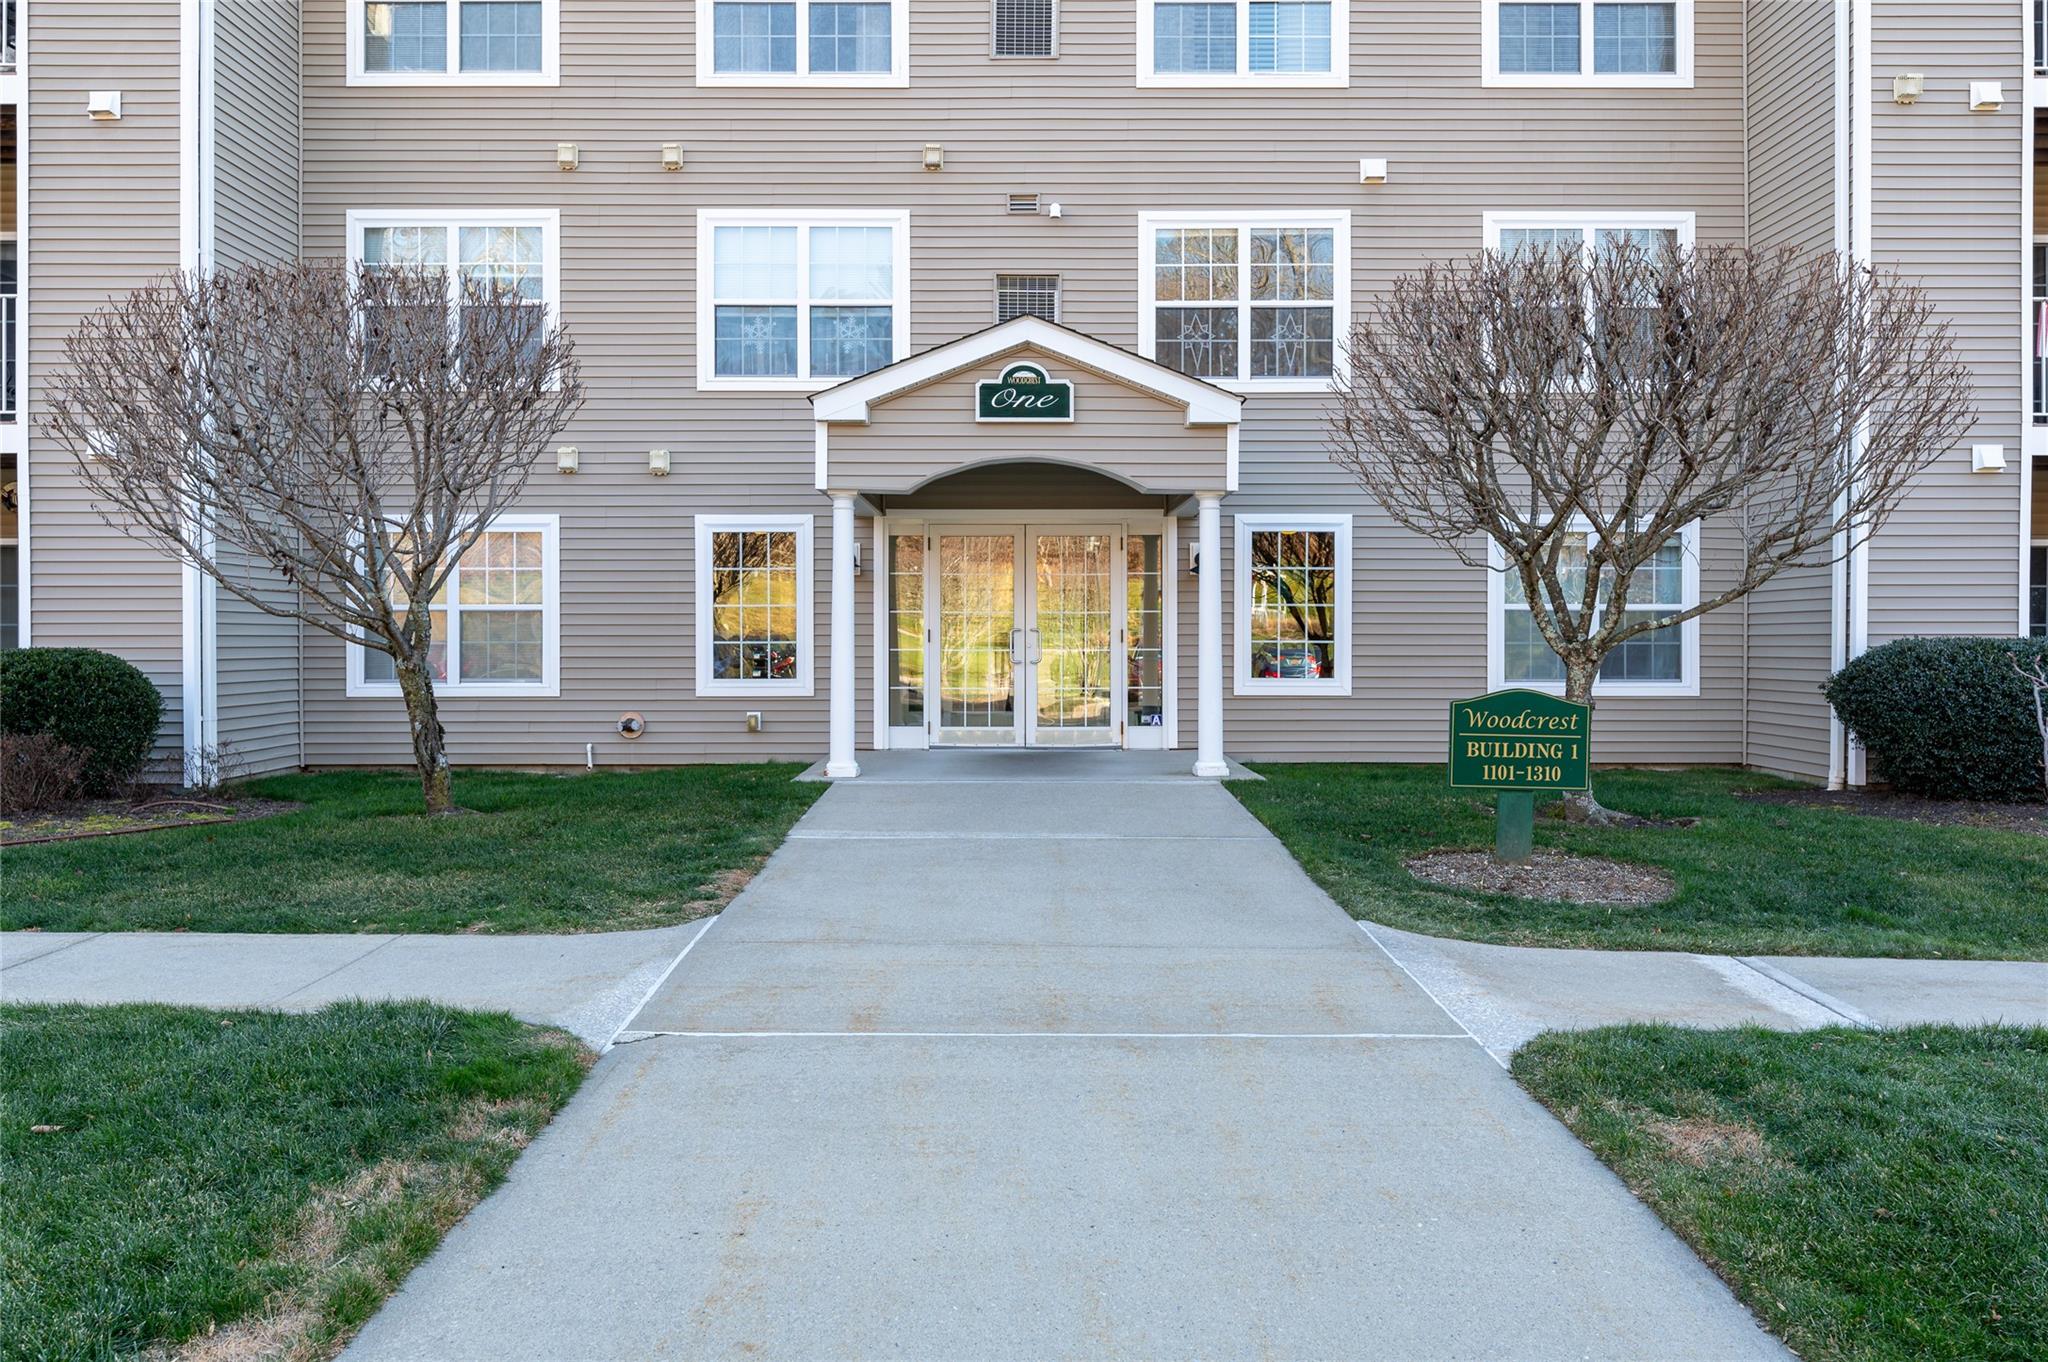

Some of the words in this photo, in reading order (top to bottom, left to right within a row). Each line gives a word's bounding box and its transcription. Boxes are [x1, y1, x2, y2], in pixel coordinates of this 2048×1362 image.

[991, 388, 1060, 408] One
[1463, 708, 1579, 730] Woodcrest
[1466, 741, 1563, 759] BUILDING
[1571, 744, 1579, 760] 1
[1482, 764, 1562, 782] 1101-1310
